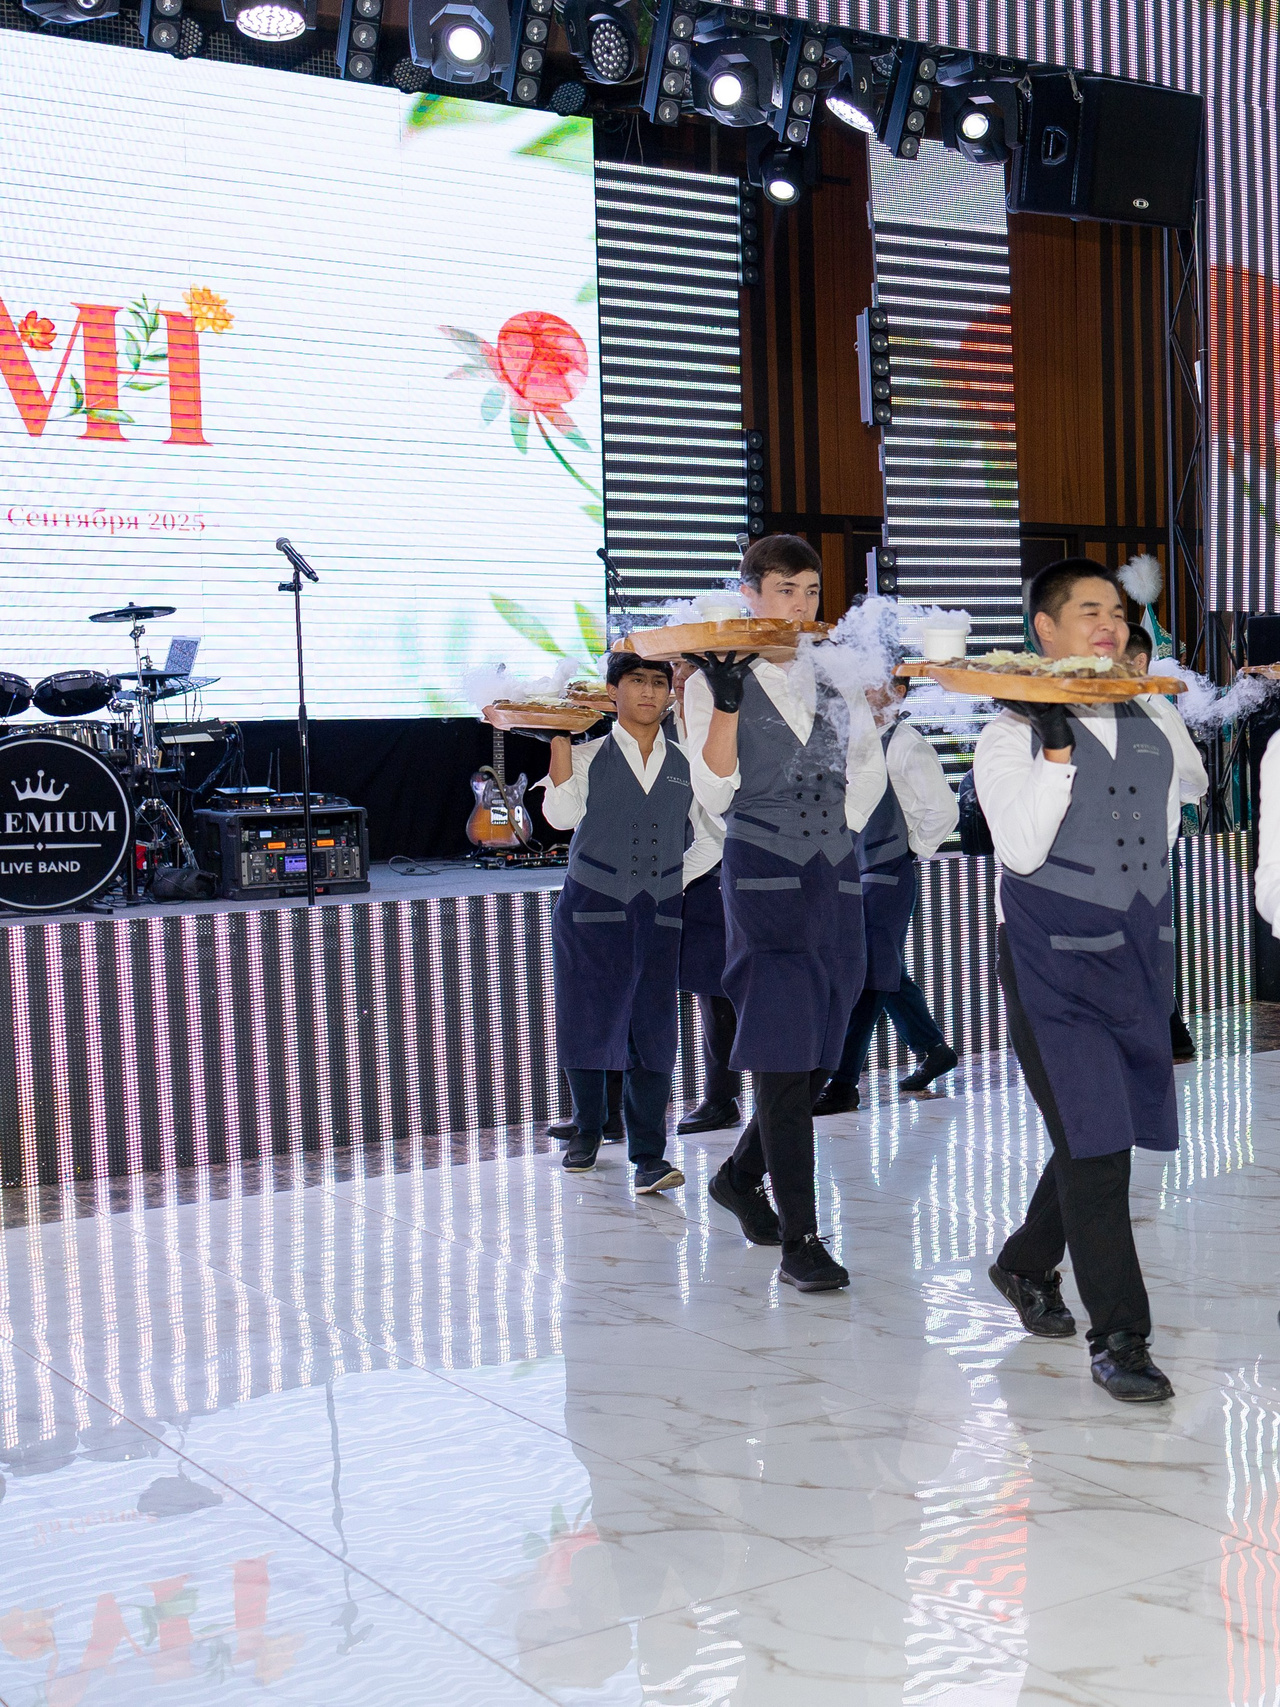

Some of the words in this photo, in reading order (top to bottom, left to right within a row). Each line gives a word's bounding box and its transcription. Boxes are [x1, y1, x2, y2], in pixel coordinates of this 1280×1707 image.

[7, 506, 139, 535] Сентября
[148, 512, 206, 532] 2025
[0, 810, 117, 834] EMIUM
[1, 861, 33, 875] LIVE
[38, 861, 81, 874] BAND
